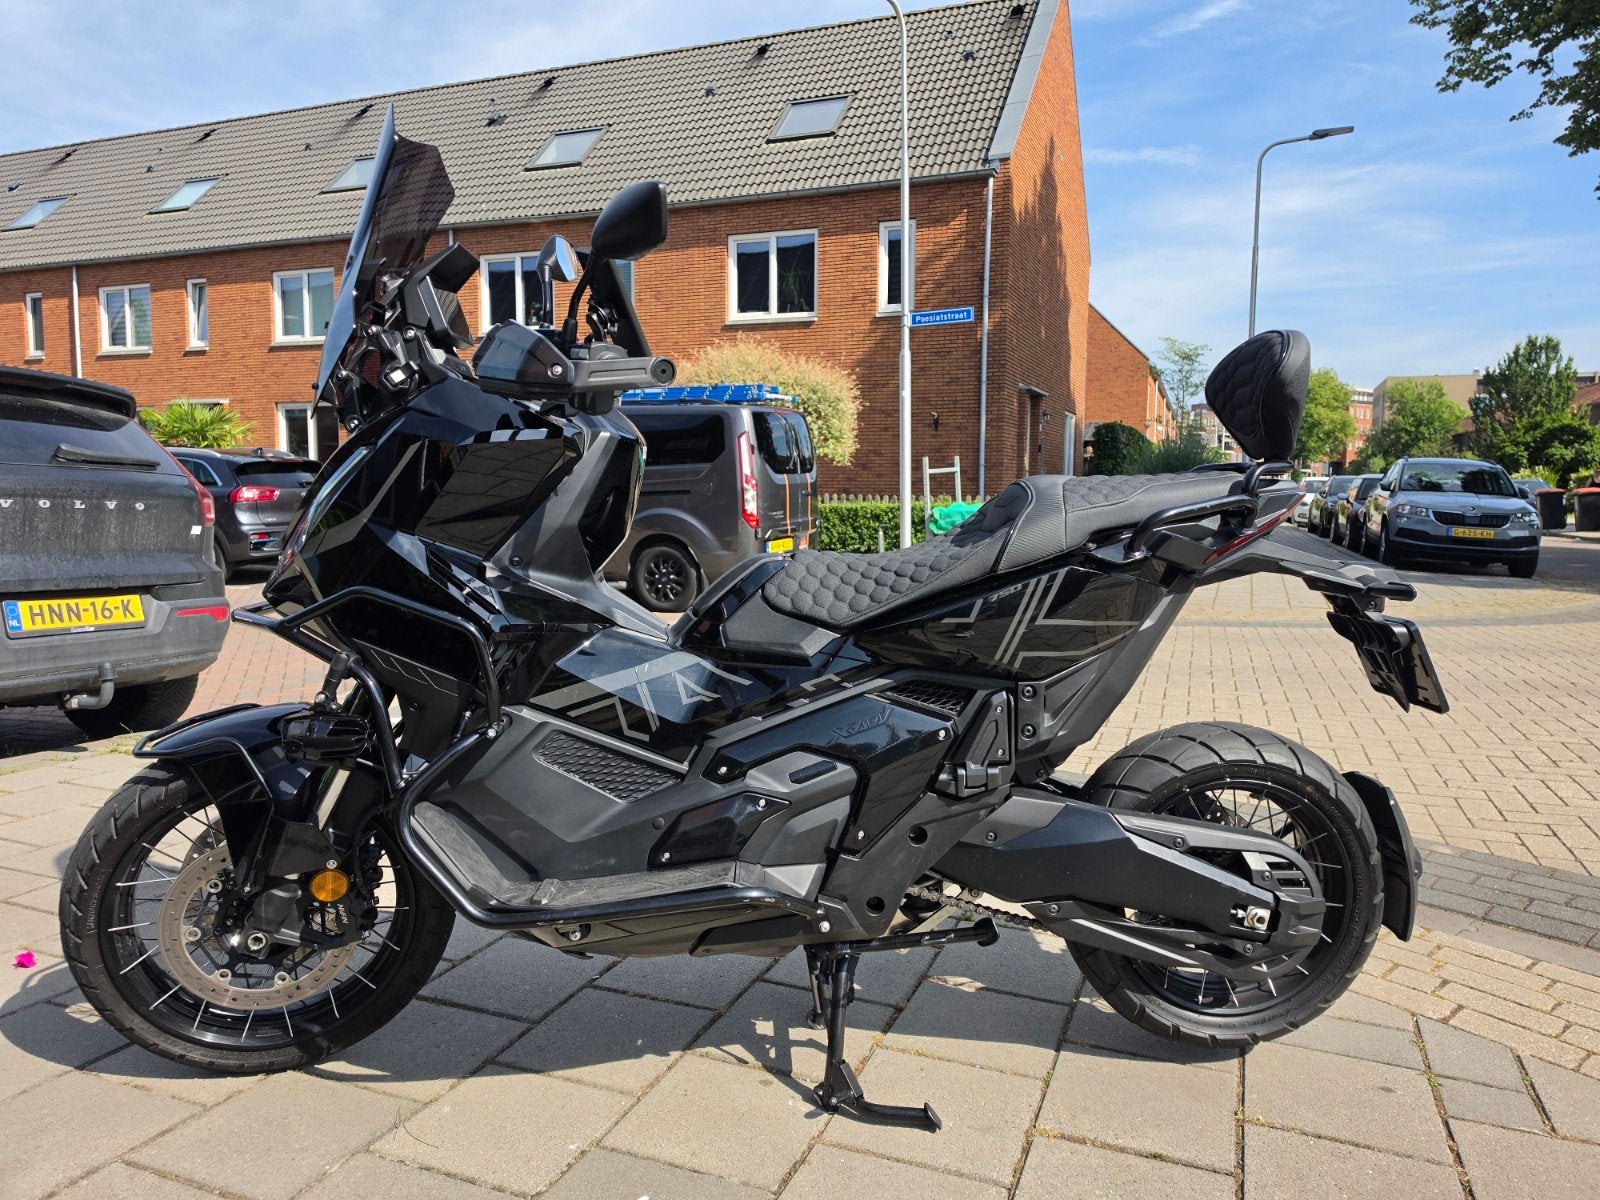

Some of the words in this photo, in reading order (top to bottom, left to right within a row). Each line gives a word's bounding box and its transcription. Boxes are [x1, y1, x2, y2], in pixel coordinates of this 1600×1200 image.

[0, 499, 145, 511] VOLVO
[28, 599, 136, 626] HNN-16-K
[9, 619, 20, 627] NL
